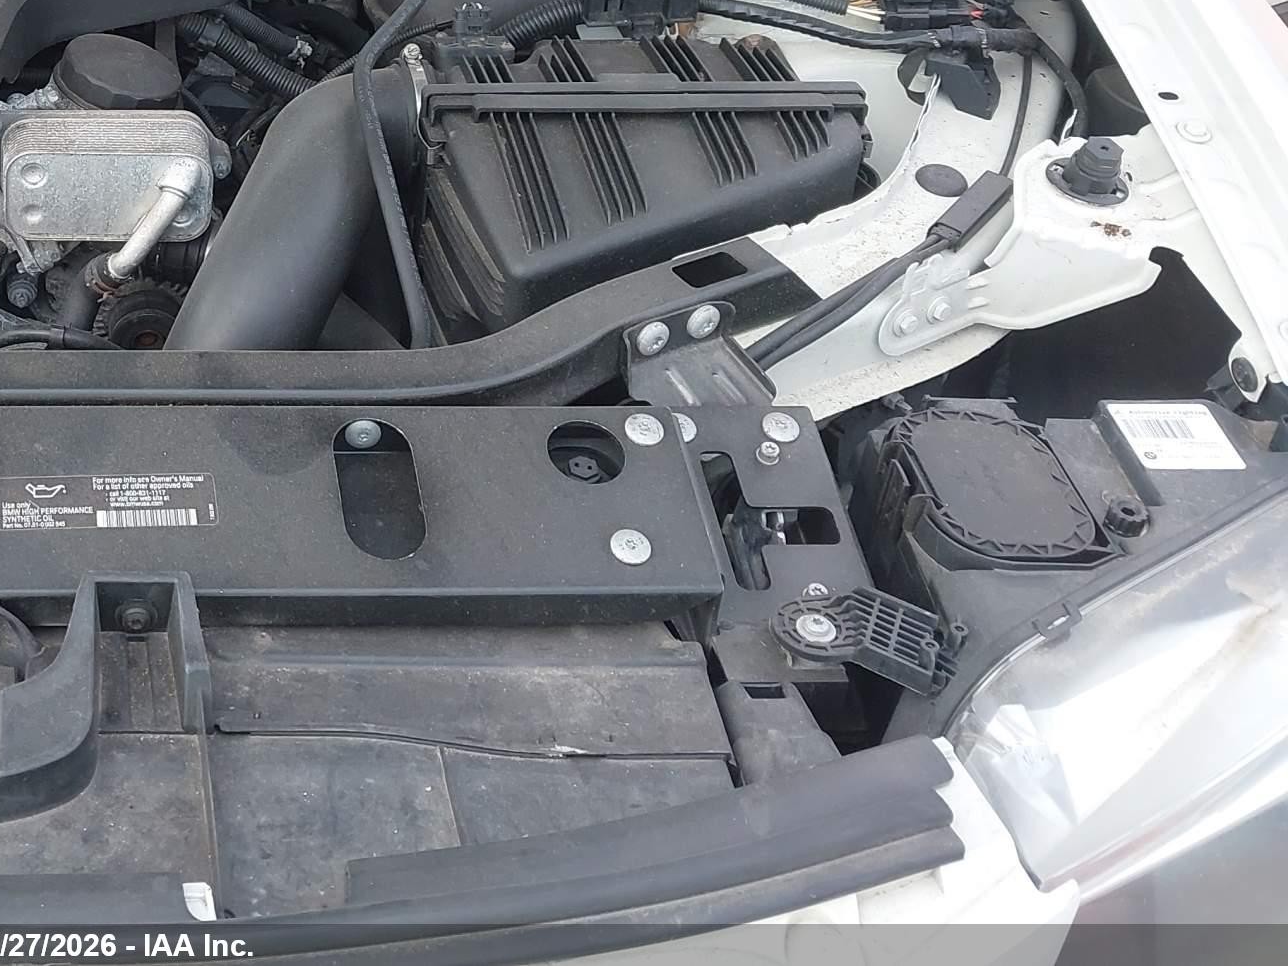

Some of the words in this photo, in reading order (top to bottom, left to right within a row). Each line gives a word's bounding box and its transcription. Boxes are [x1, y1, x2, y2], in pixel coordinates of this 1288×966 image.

[149, 483, 181, 491] approved
[16, 501, 31, 510] only
[3, 508, 20, 516] BMW
[22, 507, 40, 515] HIGH
[41, 506, 94, 514] PERFORMANCE
[3, 515, 42, 523] SYNTHETIC
[42, 514, 55, 522] OIL
